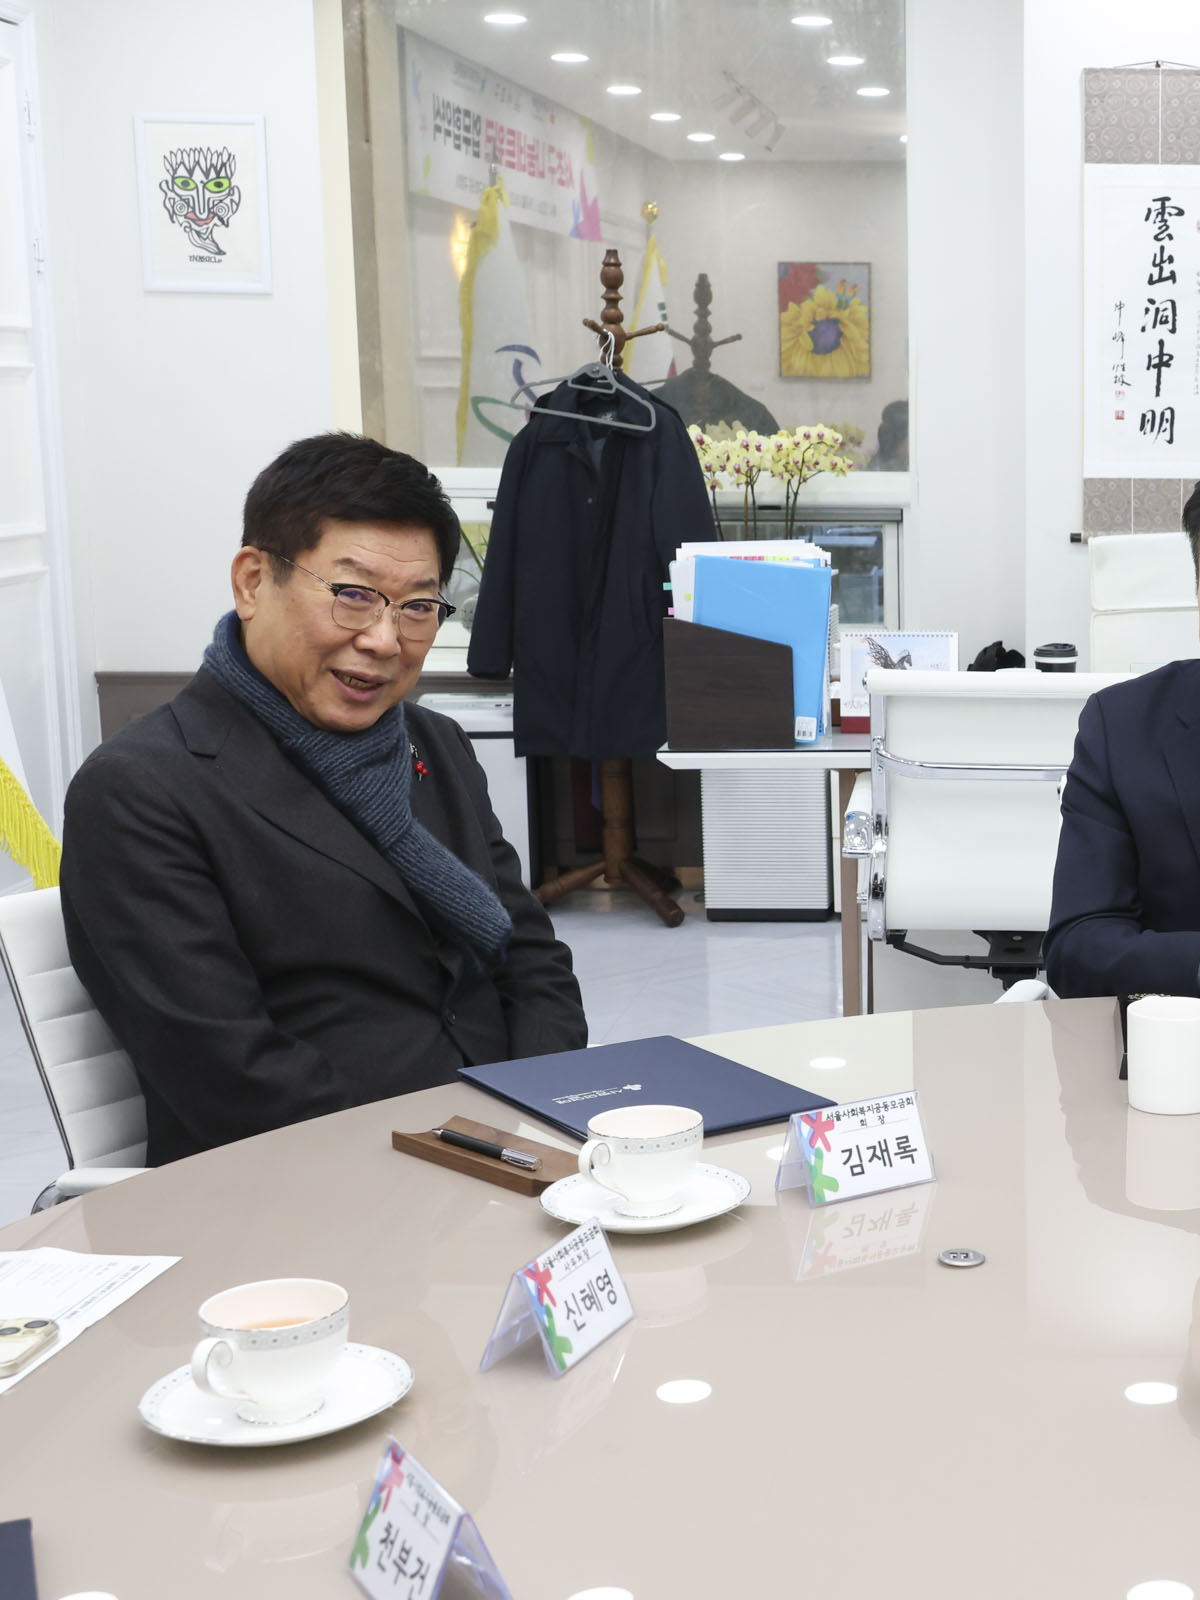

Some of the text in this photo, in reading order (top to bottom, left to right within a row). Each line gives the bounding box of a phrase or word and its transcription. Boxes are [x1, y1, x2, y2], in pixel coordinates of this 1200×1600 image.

[826, 1096, 914, 1122] 서울사회복지공동모금회
[841, 1135, 918, 1177] 김재록
[564, 1268, 618, 1332] 신혜영
